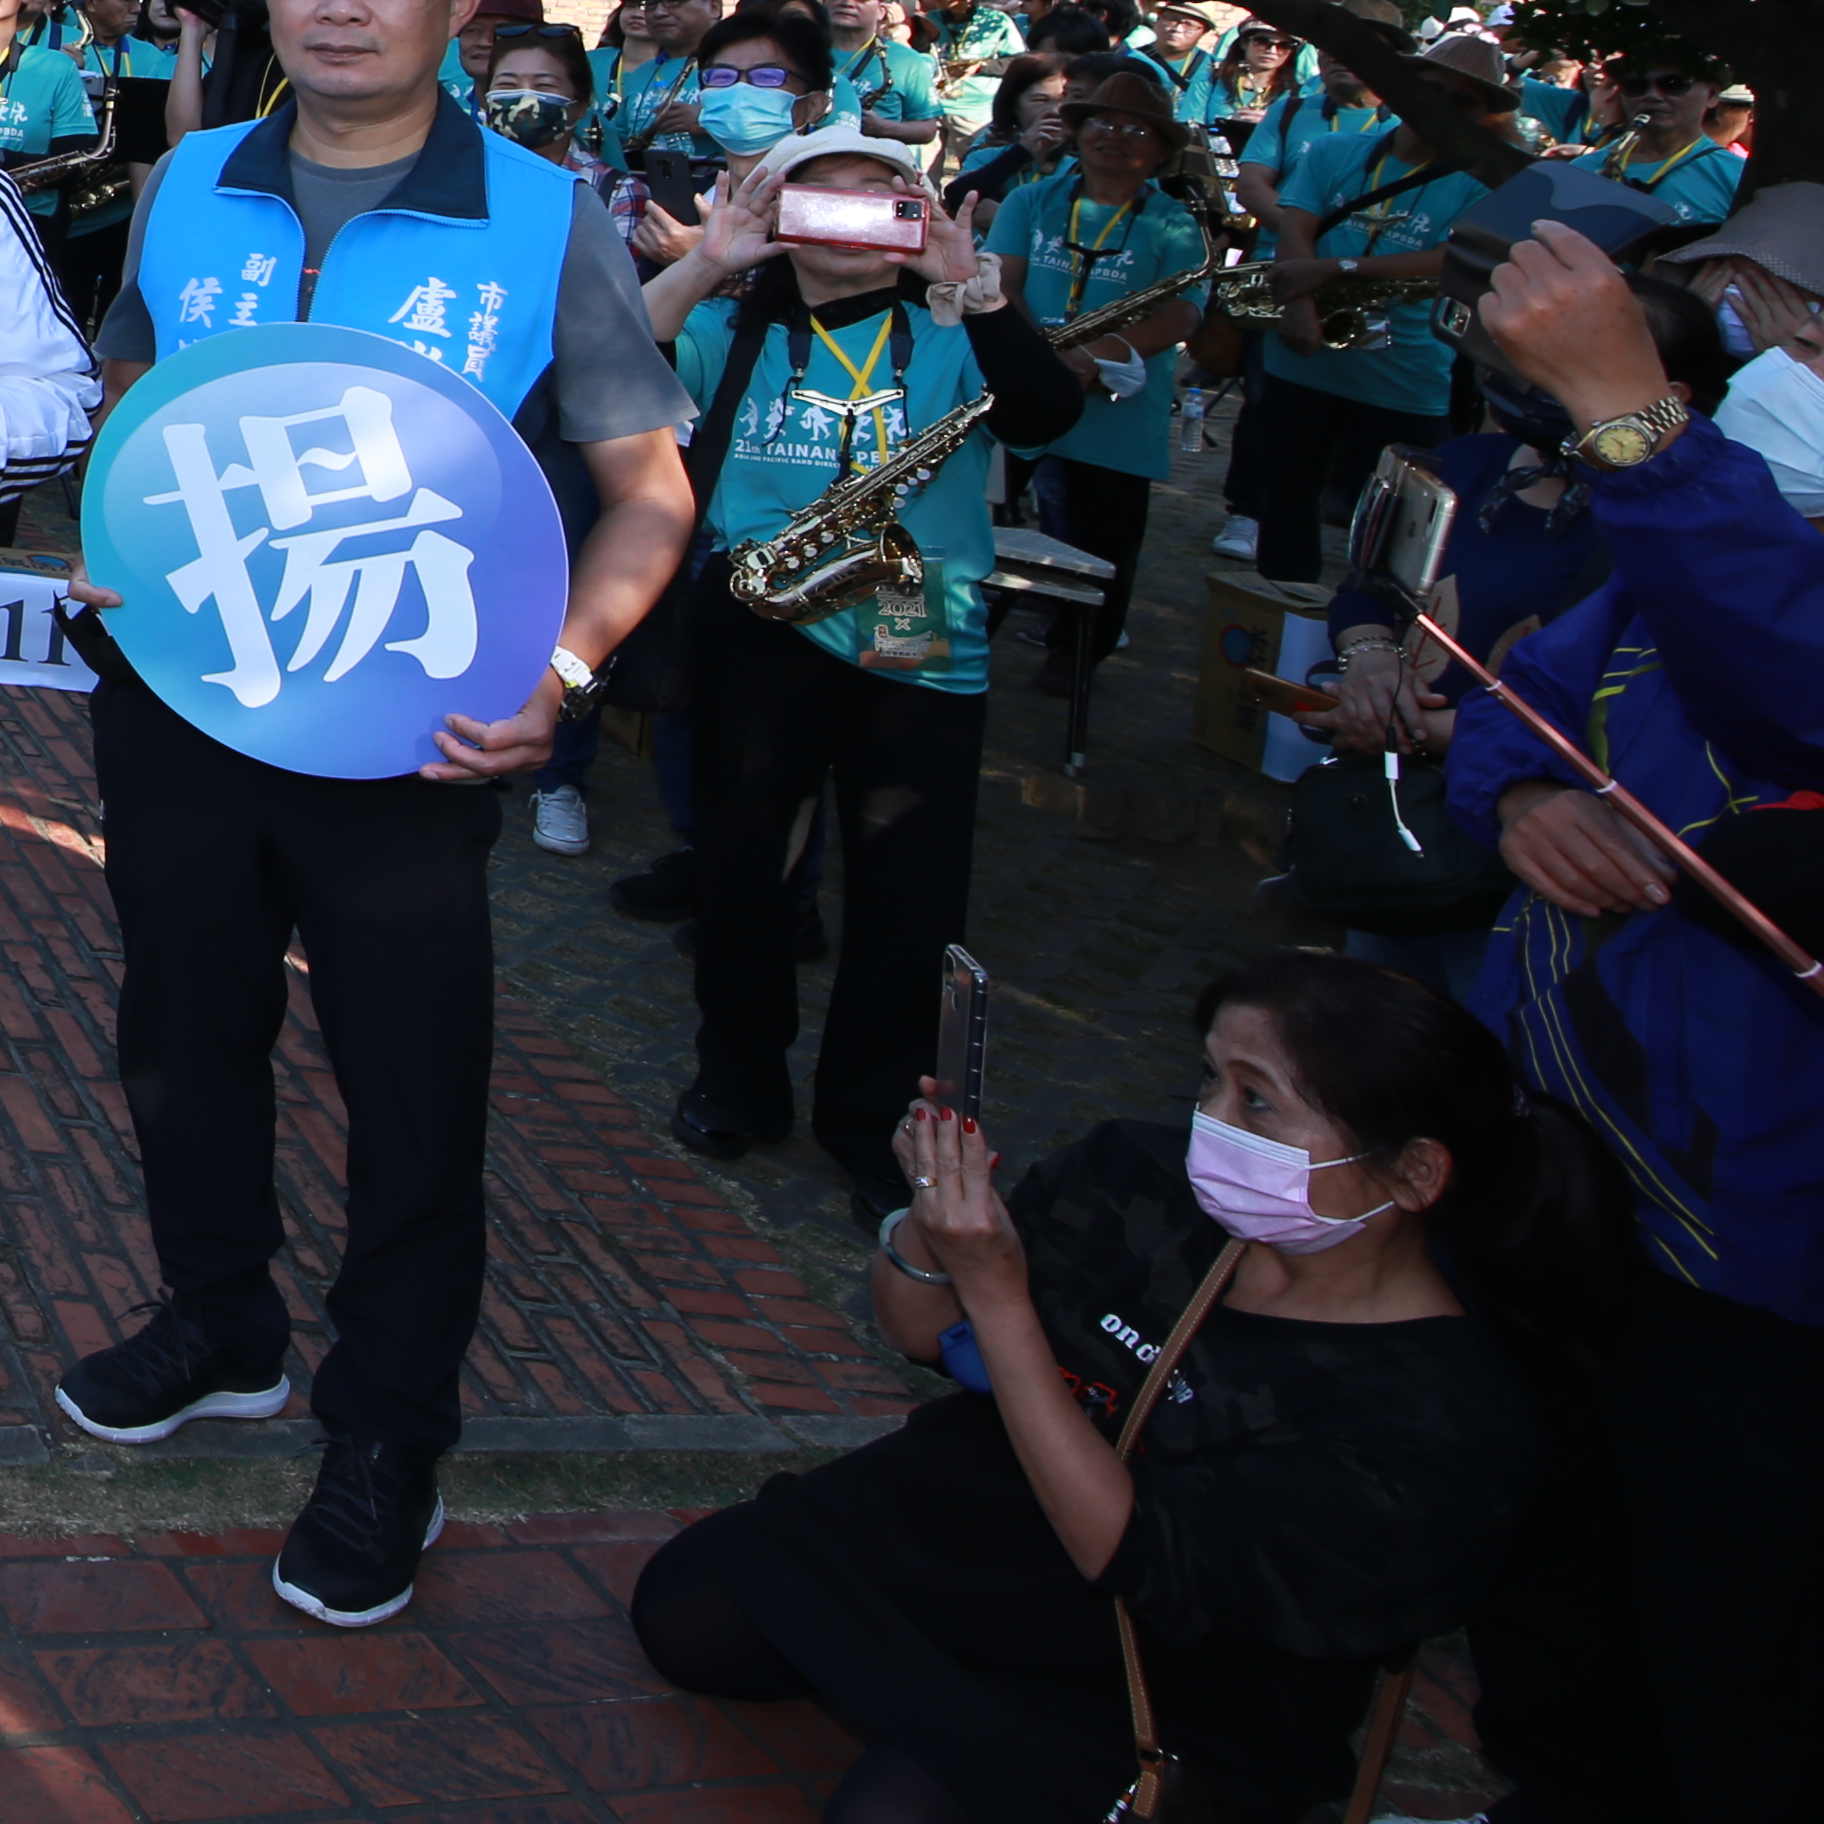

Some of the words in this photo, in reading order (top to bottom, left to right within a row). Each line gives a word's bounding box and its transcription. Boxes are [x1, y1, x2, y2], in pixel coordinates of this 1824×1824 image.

[178, 277, 224, 351] 侯
[461, 280, 509, 383] 市議員
[765, 441, 838, 461] TAINAN
[143, 385, 479, 709] 揚
